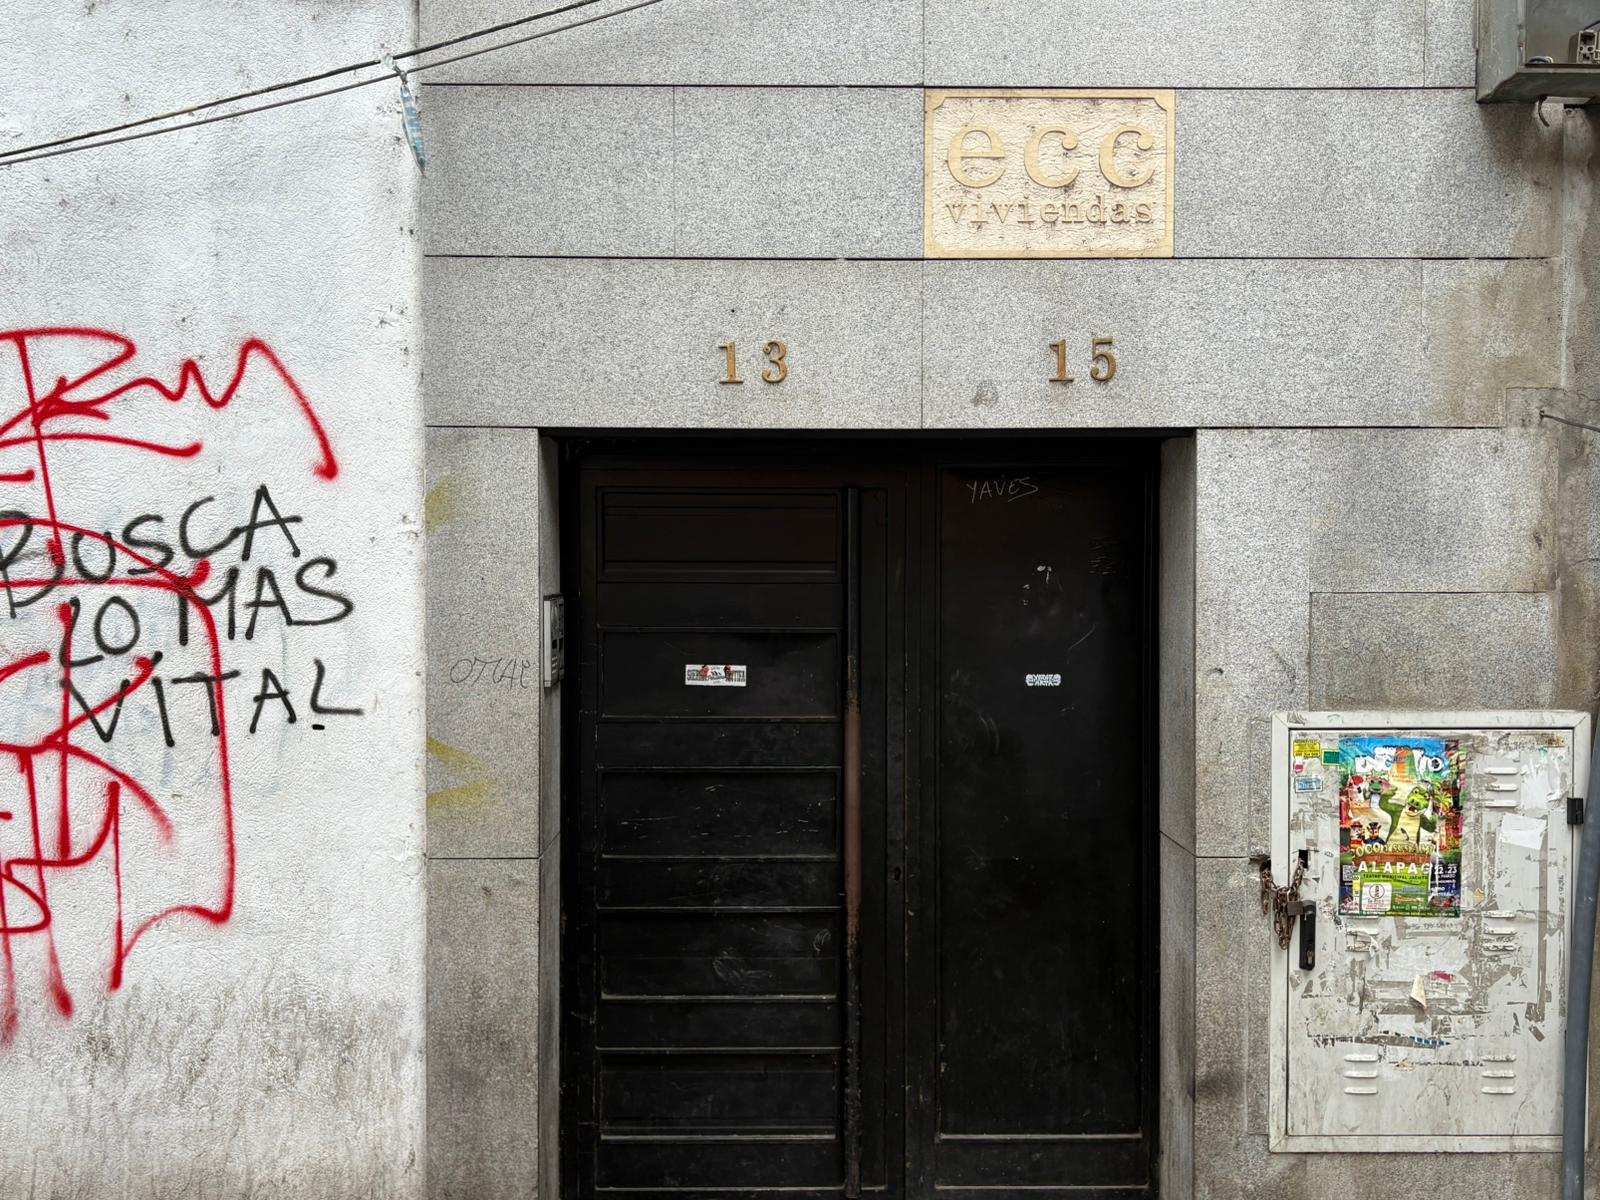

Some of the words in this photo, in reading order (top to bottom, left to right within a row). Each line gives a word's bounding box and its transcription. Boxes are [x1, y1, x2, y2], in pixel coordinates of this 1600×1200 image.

[947, 125, 1156, 188] ecc
[945, 193, 1155, 224] viviendas
[717, 340, 789, 384] 13
[1048, 336, 1118, 384] 15
[0, 484, 302, 618] BUSCA
[59, 597, 140, 668] LO
[178, 557, 354, 646] MAS
[1447, 865, 1458, 874] 23
